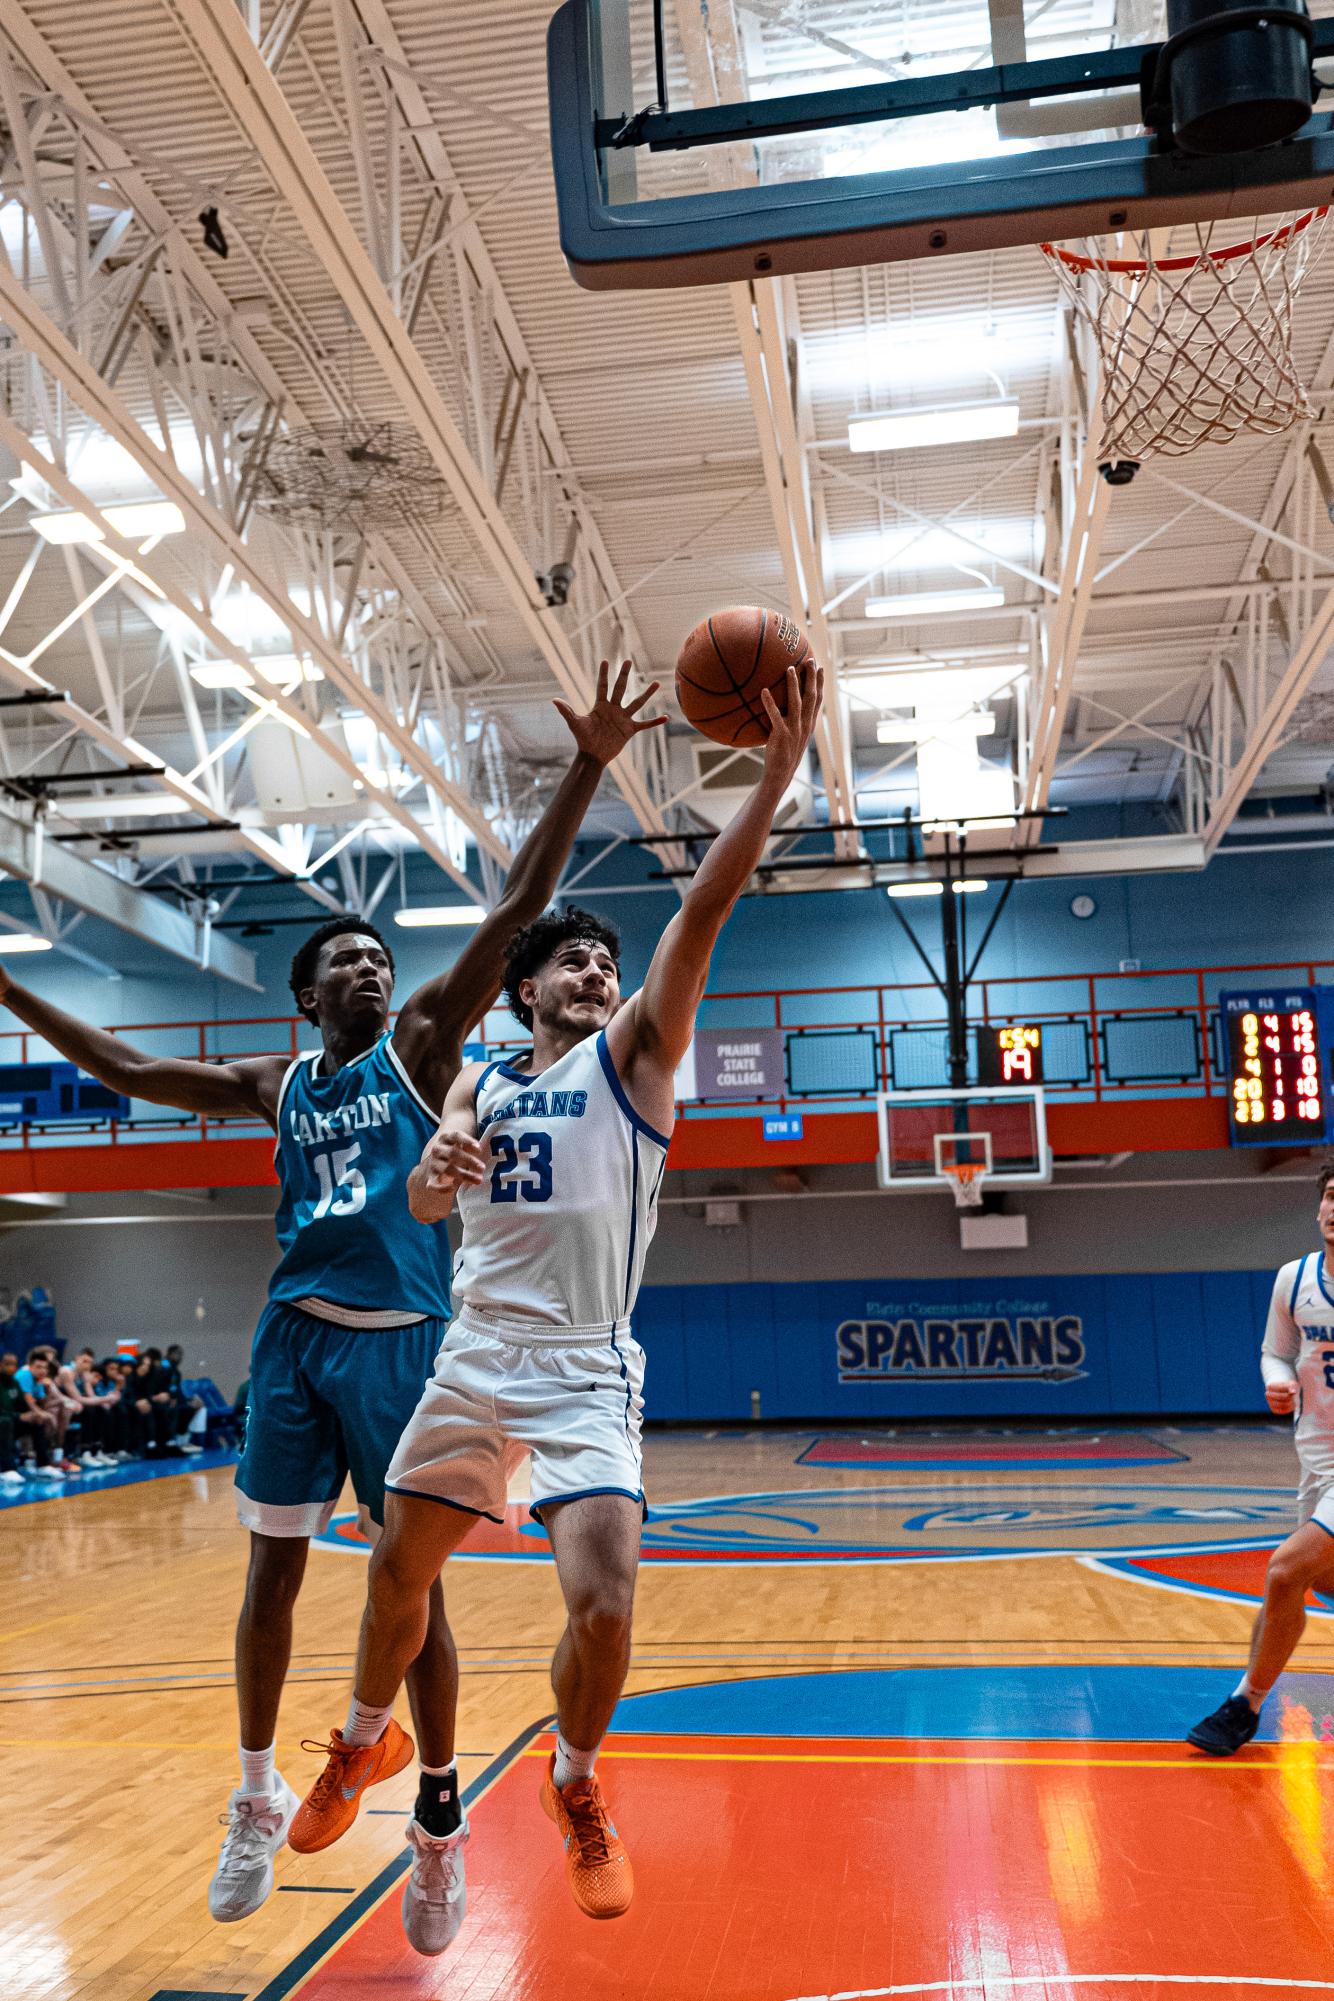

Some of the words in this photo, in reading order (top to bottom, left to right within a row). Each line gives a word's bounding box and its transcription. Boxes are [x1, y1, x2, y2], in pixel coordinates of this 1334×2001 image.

[1242, 1013, 1258, 1035] 0
[1264, 1014, 1278, 1032] 4
[1291, 1011, 1313, 1033] 15
[1000, 1027, 1039, 1048] 1:54
[1244, 1035, 1259, 1056] 2
[1265, 1035, 1280, 1053] 4
[1293, 1032, 1315, 1053] 15
[717, 1043, 762, 1057] PRAIRIE
[724, 1058, 755, 1071] STATE
[1004, 1048, 1031, 1079] 19
[1245, 1058, 1261, 1077] 4
[1275, 1058, 1282, 1076] 1
[1302, 1055, 1316, 1075] 0
[717, 1071, 765, 1086] COLLEGE
[1233, 1078, 1262, 1100] 20
[1276, 1078, 1283, 1096] 1
[1297, 1075, 1318, 1097] 10
[1235, 1100, 1264, 1122] 23
[1272, 1099, 1285, 1120] 3
[490, 1132, 553, 1203] 23
[313, 1141, 367, 1219] 15
[995, 1300, 1049, 1314] College
[836, 1315, 1085, 1370] SPARTANS
